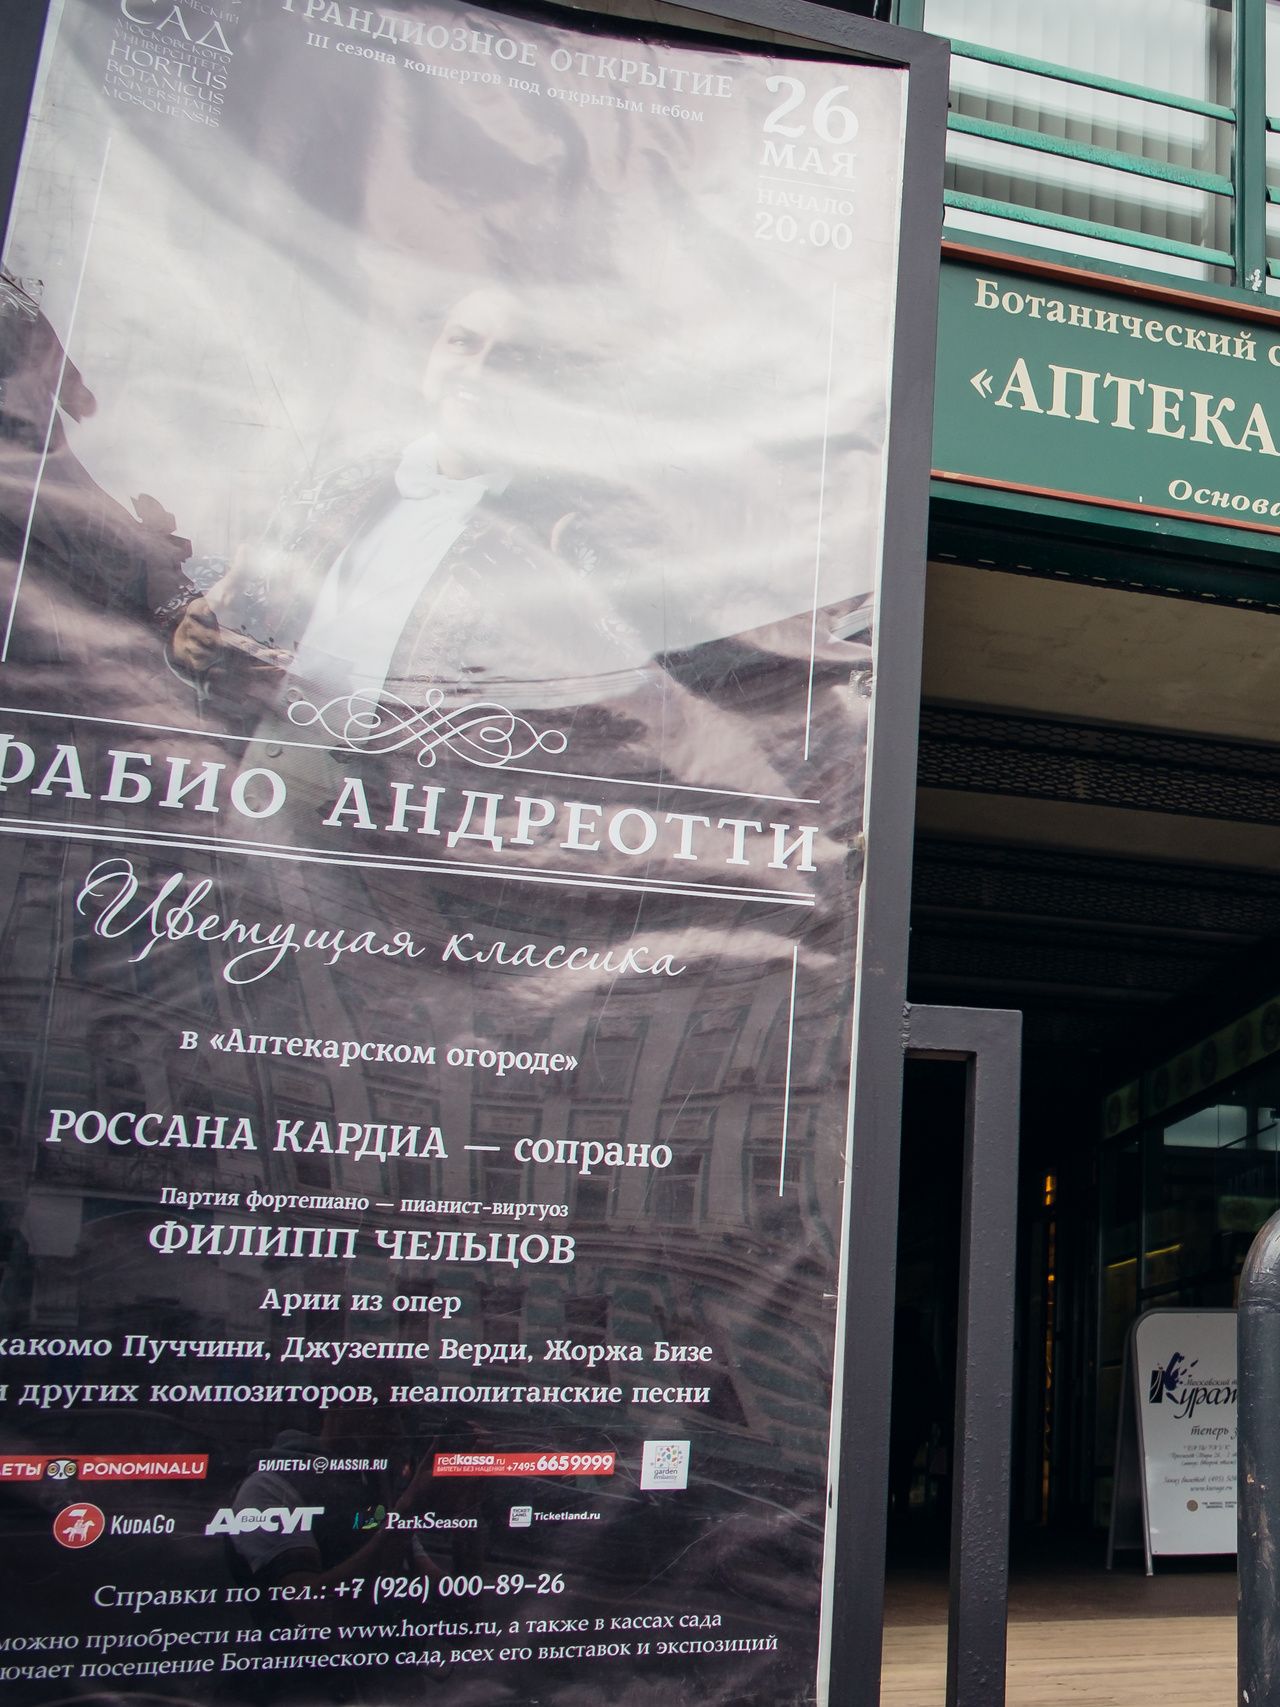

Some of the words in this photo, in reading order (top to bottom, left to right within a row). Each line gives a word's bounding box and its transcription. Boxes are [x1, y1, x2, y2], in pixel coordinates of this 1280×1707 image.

[112, 28, 229, 75] УНИВЕРСИТЕТА
[117, 18, 231, 63] МОСКОВСКОГО
[106, 59, 224, 104] BOTANICUS
[110, 40, 227, 90] HORTUS
[336, 40, 396, 65] сезона
[404, 57, 502, 86] концертов
[508, 76, 541, 97] под
[547, 84, 644, 114] открытым
[651, 102, 705, 123] небом
[551, 48, 735, 98] ОТКРЫТИЕ
[102, 85, 219, 128] MOSQUENSIS
[104, 73, 221, 115] UNIVERSITATIS
[763, 75, 859, 144] 26
[759, 140, 857, 179] МАЯ
[756, 187, 854, 217] НАЧАЛО
[754, 211, 853, 250] 20.00
[976, 278, 1258, 363] Ботанический
[322, 777, 819, 871] АНДРЕОТТИ
[77, 858, 426, 984] Цветущая
[441, 932, 687, 977] классика
[179, 1030, 198, 1050] в
[209, 1028, 436, 1067] «Аптекарском
[446, 1047, 579, 1076] огороде»
[45, 1109, 258, 1150] РОССАНА
[273, 1119, 448, 1162] КАРДИА
[514, 1138, 673, 1174] сопрано
[159, 1187, 239, 1209] Партия
[246, 1190, 370, 1212] фортепиано
[149, 1220, 360, 1258] ФИЛИПП
[374, 1229, 576, 1268] ЧЕЛЬЦОВ
[259, 1288, 340, 1317] Арии
[350, 1294, 383, 1311] из
[392, 1295, 462, 1319] опер
[122, 1335, 271, 1364] Пуччини,
[280, 1337, 430, 1365] Джузеппе
[439, 1339, 533, 1366] Верди,
[544, 1340, 643, 1367] Жоржа
[653, 1342, 713, 1362] Бизе
[18, 1383, 139, 1409] других
[149, 1385, 379, 1409] композиторов,
[389, 1385, 622, 1403] неаполитанские
[631, 1387, 711, 1403] песни
[1190, 1425, 1229, 1440] теперь
[0, 1462, 42, 1476] ЕТЫ
[82, 1461, 205, 1475] PONOMINALU
[258, 1459, 311, 1471] БИЛЕТЫ
[329, 1459, 388, 1471] KASSIR.RU
[437, 1454, 506, 1466] redkassa.ru
[654, 1468, 678, 1476] garden
[385, 1512, 478, 1530] ParkSeason
[533, 1511, 601, 1521] Ticketland.ru
[94, 1585, 217, 1613] Справки
[225, 1588, 260, 1604] по
[268, 1585, 327, 1601] тел.:
[334, 1578, 364, 1600] +7
[373, 1575, 430, 1605] (926)
[86, 1628, 230, 1654] приобрести
[236, 1627, 262, 1643] на
[269, 1624, 331, 1641] сайте
[338, 1617, 503, 1639] www.hortus.ru,
[508, 1622, 520, 1634] а
[525, 1619, 589, 1634] также
[595, 1618, 605, 1631] в
[610, 1613, 675, 1630] кассах
[679, 1614, 722, 1630] сада
[80, 1658, 215, 1679] посещение
[221, 1650, 389, 1672] Ботанического
[394, 1650, 447, 1668] сада,
[450, 1646, 493, 1662] всех
[499, 1646, 532, 1663] его
[538, 1640, 632, 1659] выставок
[637, 1640, 650, 1654] и
[656, 1634, 778, 1655] экспозиций
